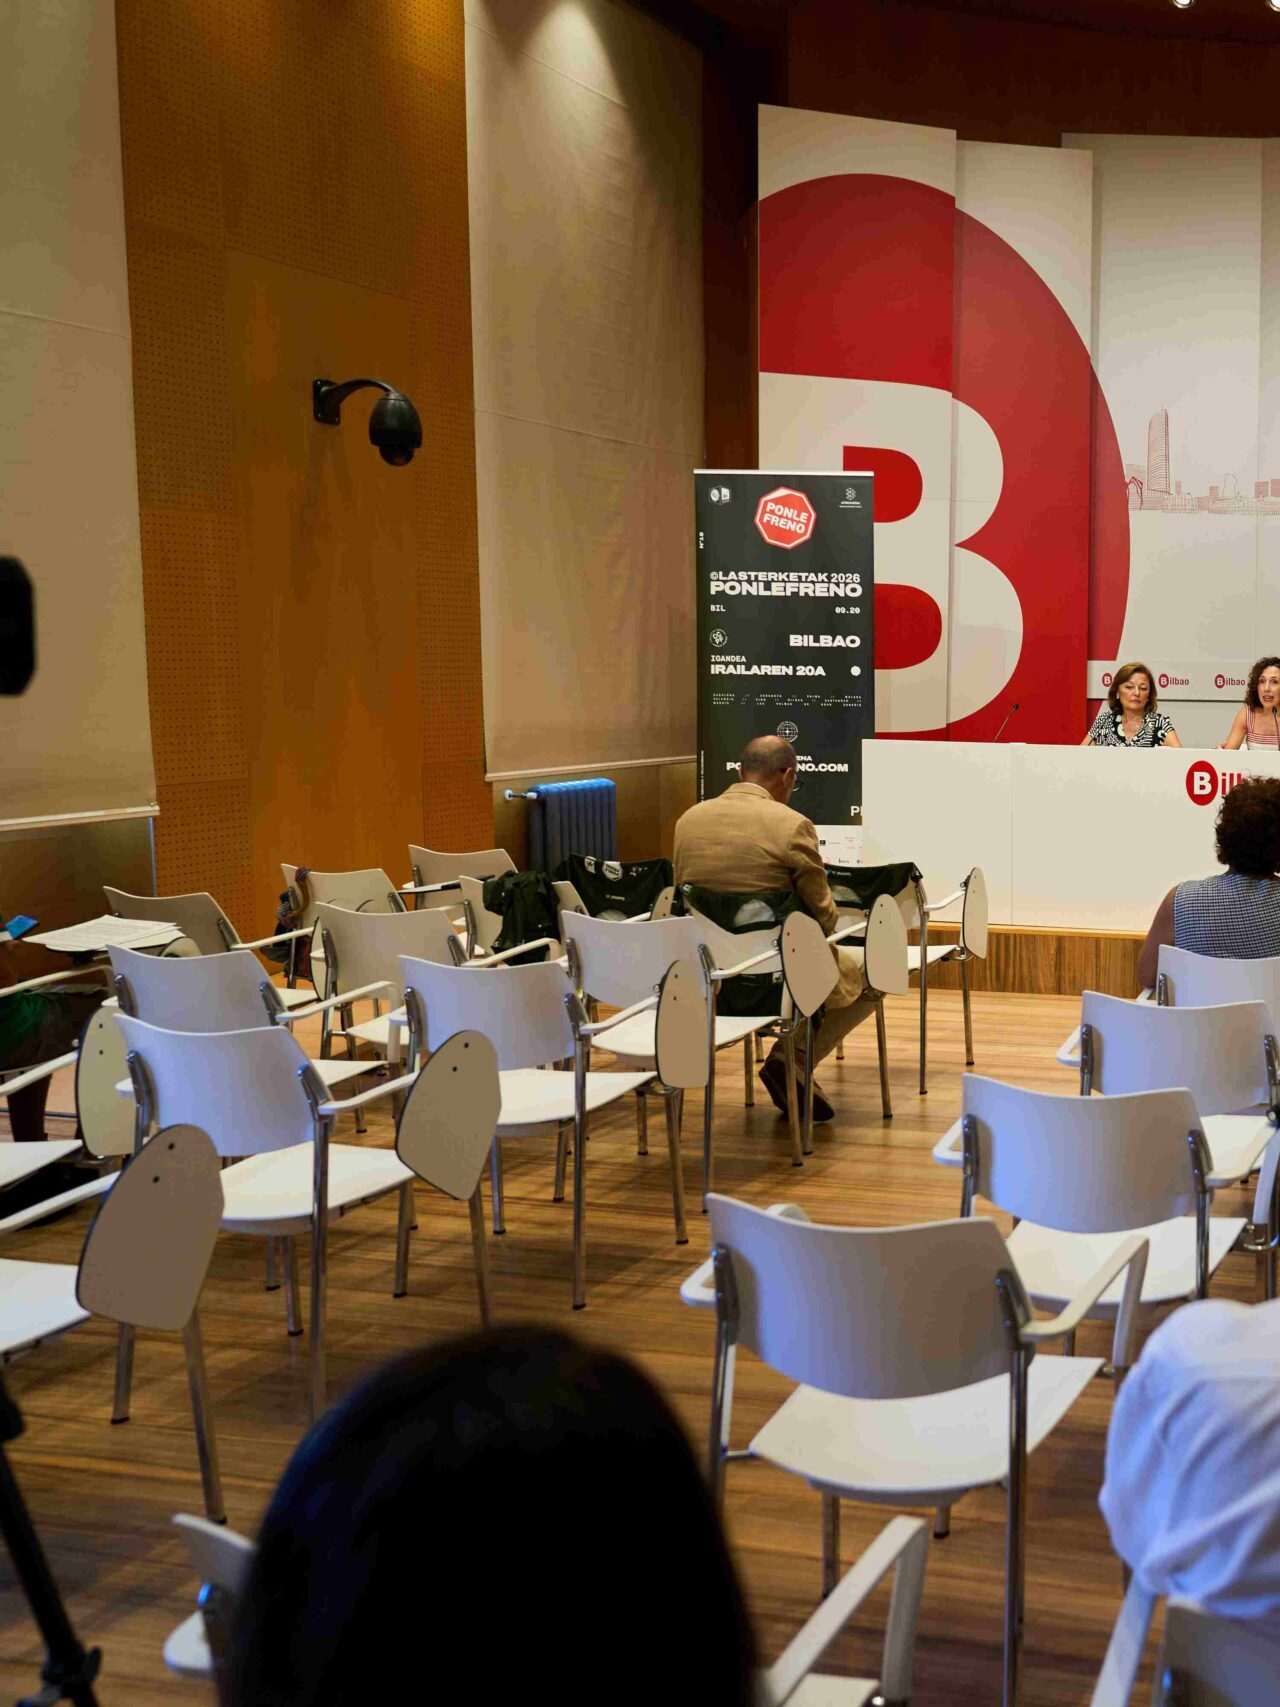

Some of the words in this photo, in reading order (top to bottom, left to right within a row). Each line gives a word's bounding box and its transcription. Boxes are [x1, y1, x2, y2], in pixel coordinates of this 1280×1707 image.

[766, 501, 809, 524] PONLE
[762, 513, 806, 534] FRENO
[830, 572, 861, 583] 2026
[709, 580, 863, 598] PONLEFRENO
[710, 604, 727, 612] BIL
[789, 634, 861, 648] BILBAO
[710, 664, 794, 676] IRAILAREN
[795, 665, 826, 676] 20A
[1159, 675, 1190, 688] Bilbao
[1215, 675, 1246, 688] Bilbao
